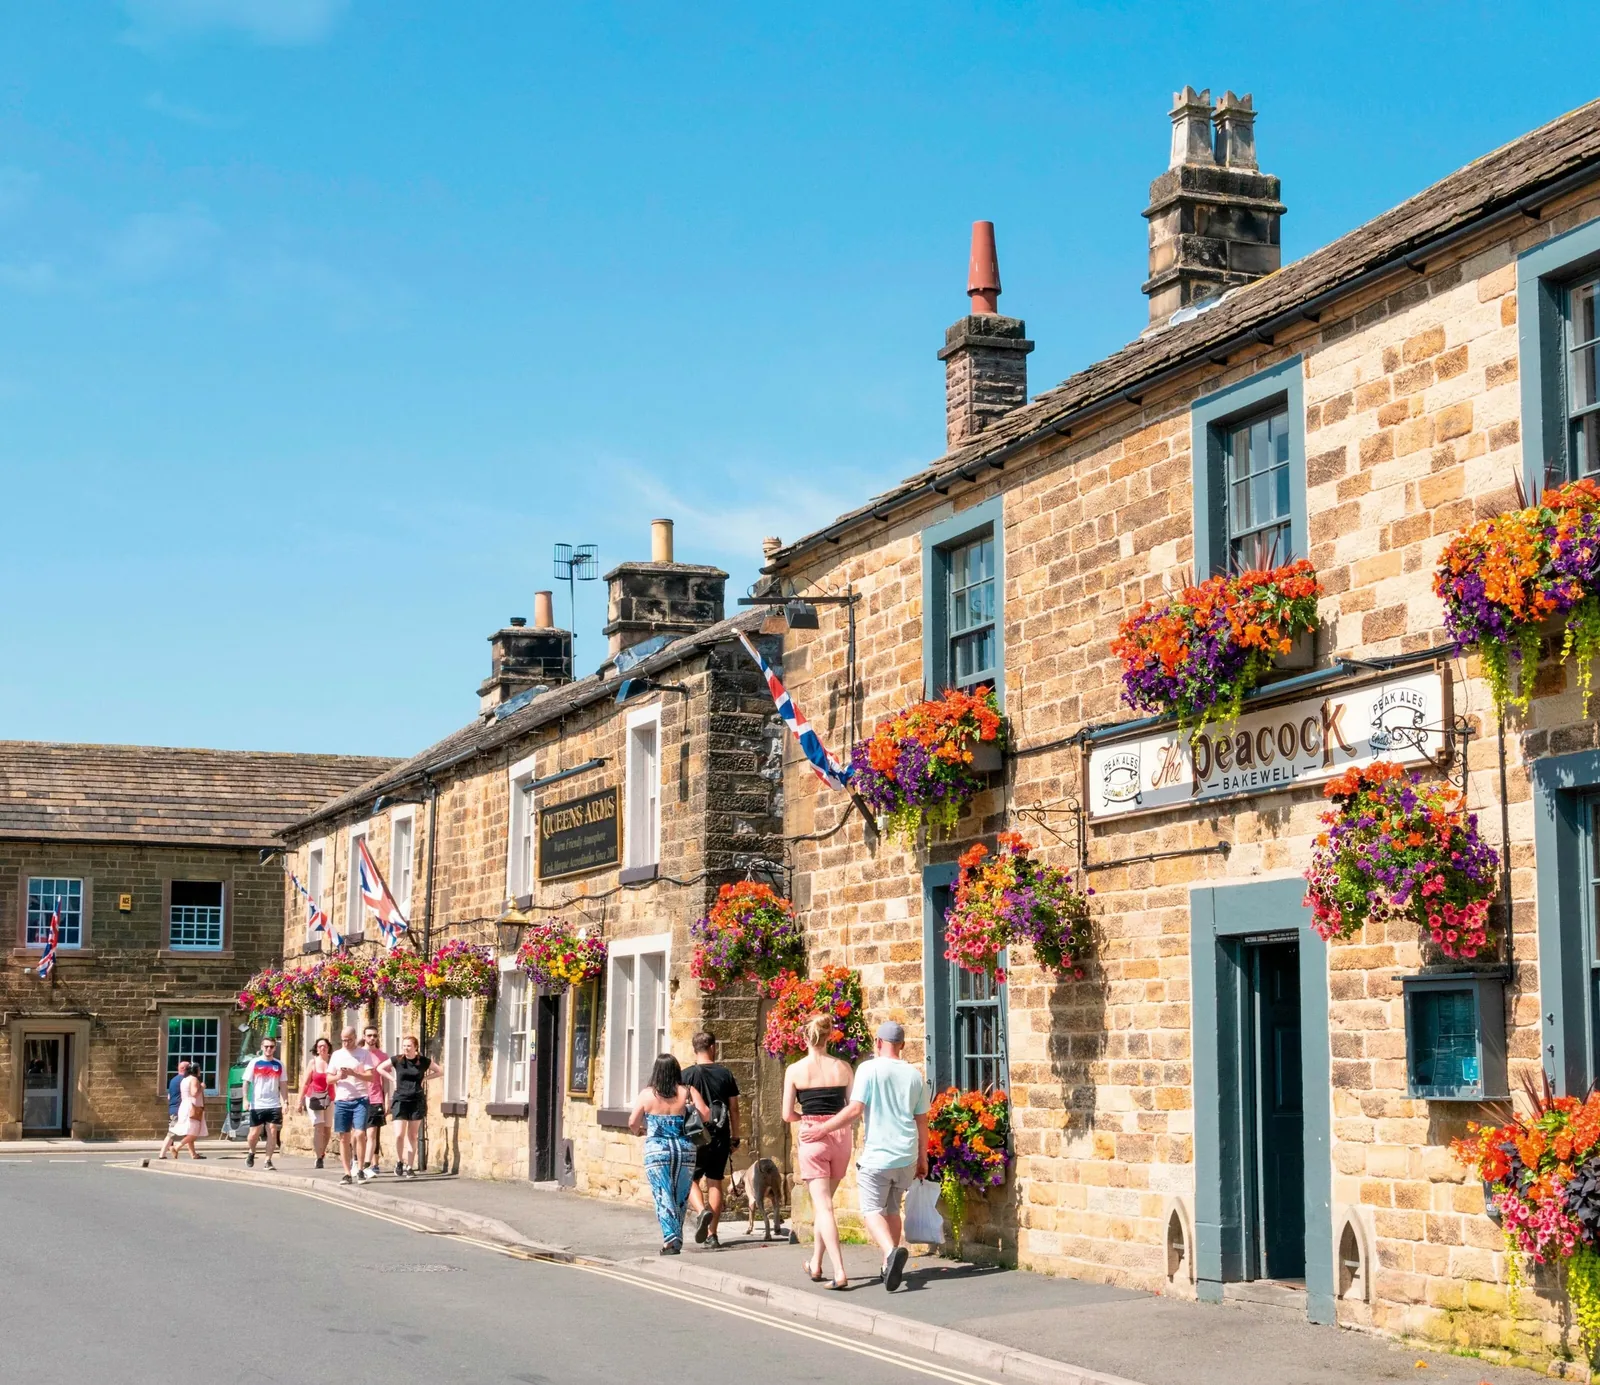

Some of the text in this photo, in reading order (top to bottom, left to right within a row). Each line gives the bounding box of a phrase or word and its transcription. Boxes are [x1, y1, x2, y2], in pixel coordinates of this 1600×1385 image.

[1372, 691, 1423, 715] PEAK ALES
[1103, 755, 1139, 773] PEAK ALES
[1151, 739, 1183, 790] The
[1222, 764, 1299, 790] BAKEWELL
[542, 795, 616, 840] QUEENS ARMS
[595, 849, 606, 861] Since
